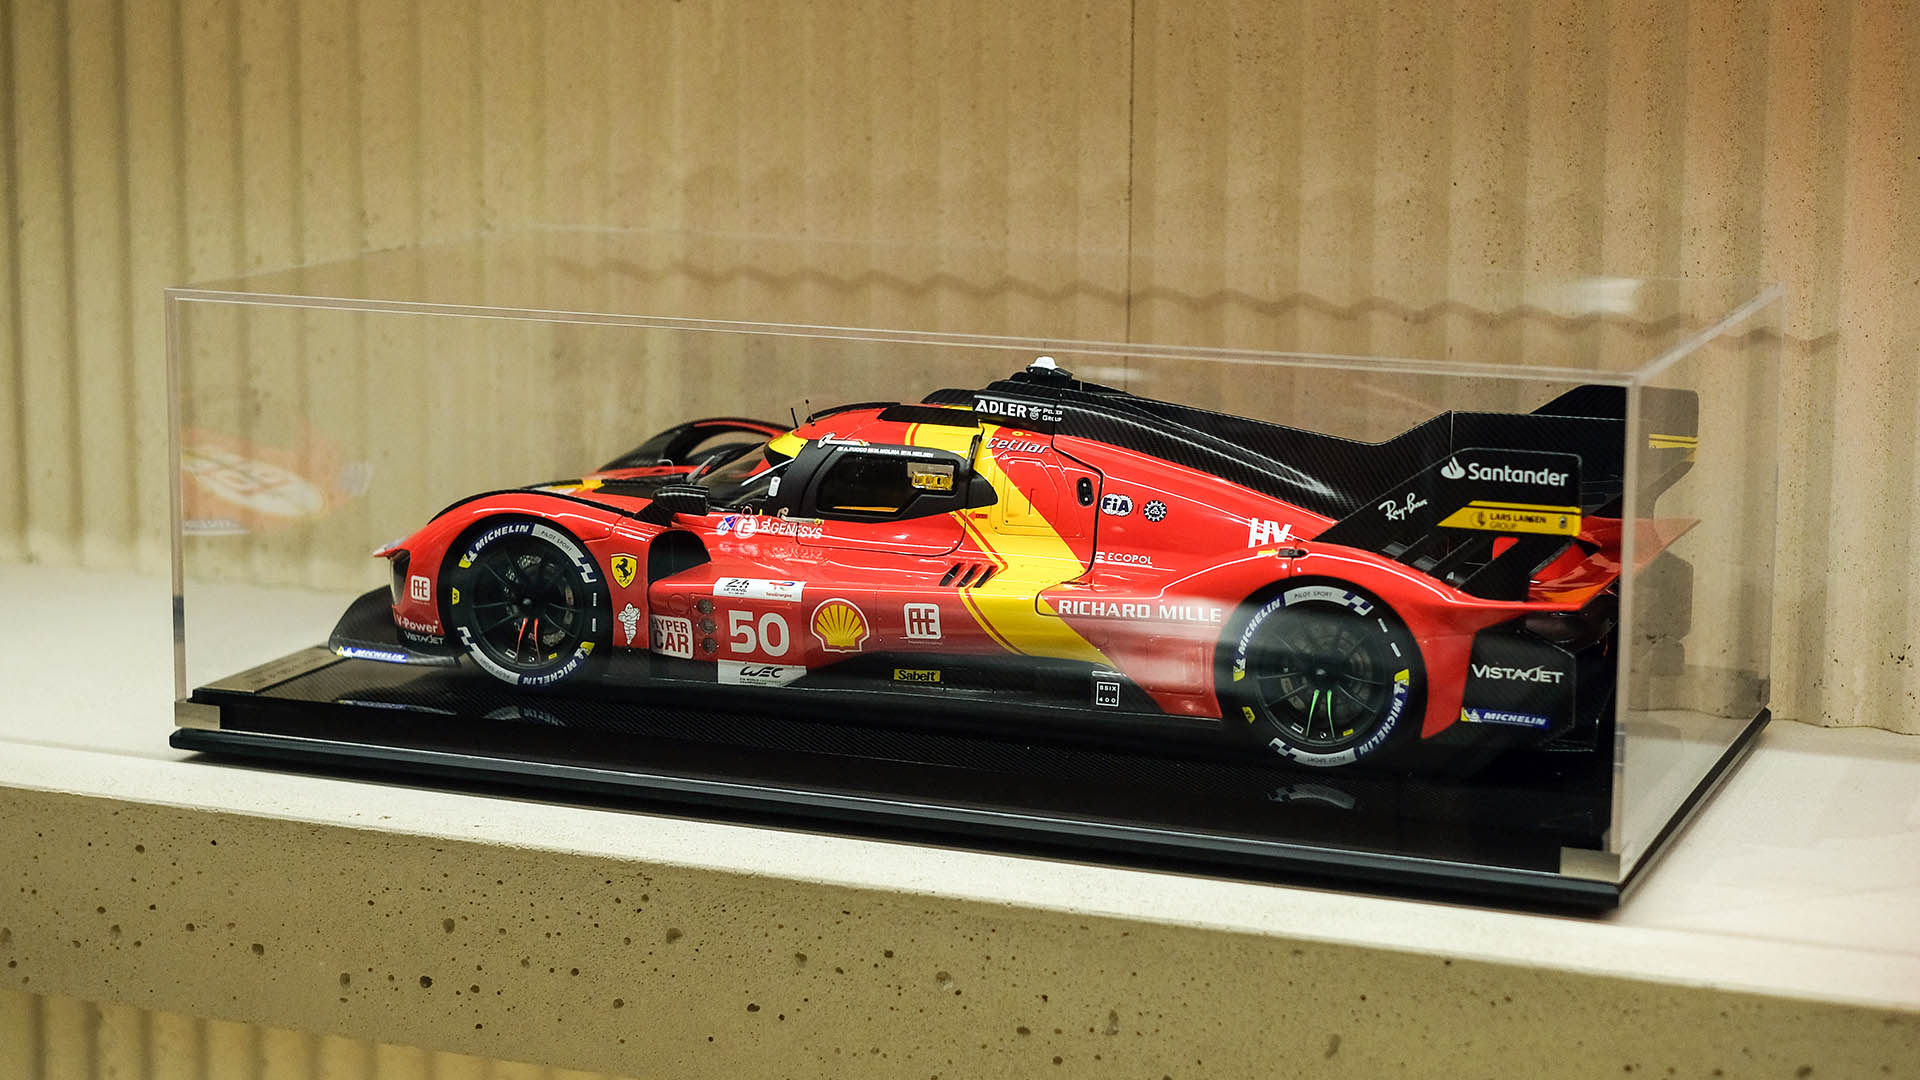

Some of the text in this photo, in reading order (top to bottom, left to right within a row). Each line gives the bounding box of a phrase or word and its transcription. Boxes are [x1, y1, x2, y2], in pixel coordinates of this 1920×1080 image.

[975, 400, 1026, 418] ADLER
[986, 437, 1049, 453] Cetilar
[1468, 463, 1569, 486] Santander
[1378, 493, 1427, 521] Ray-Ban
[1490, 512, 1511, 522] LARS
[475, 524, 530, 551] MICHELIN
[1107, 552, 1152, 565] ECOPOL
[1058, 600, 1222, 623] RICHARD MILLE
[651, 617, 689, 634] HYPER
[728, 610, 790, 656] 50
[1238, 598, 1281, 656] MICHELIN
[654, 630, 689, 653] CAR
[523, 659, 577, 685] MICHELIN
[740, 666, 784, 678] WEC
[898, 670, 936, 681] Sabelt
[1358, 697, 1404, 755] MICHELIN
[1483, 711, 1547, 726] MICHELIN
